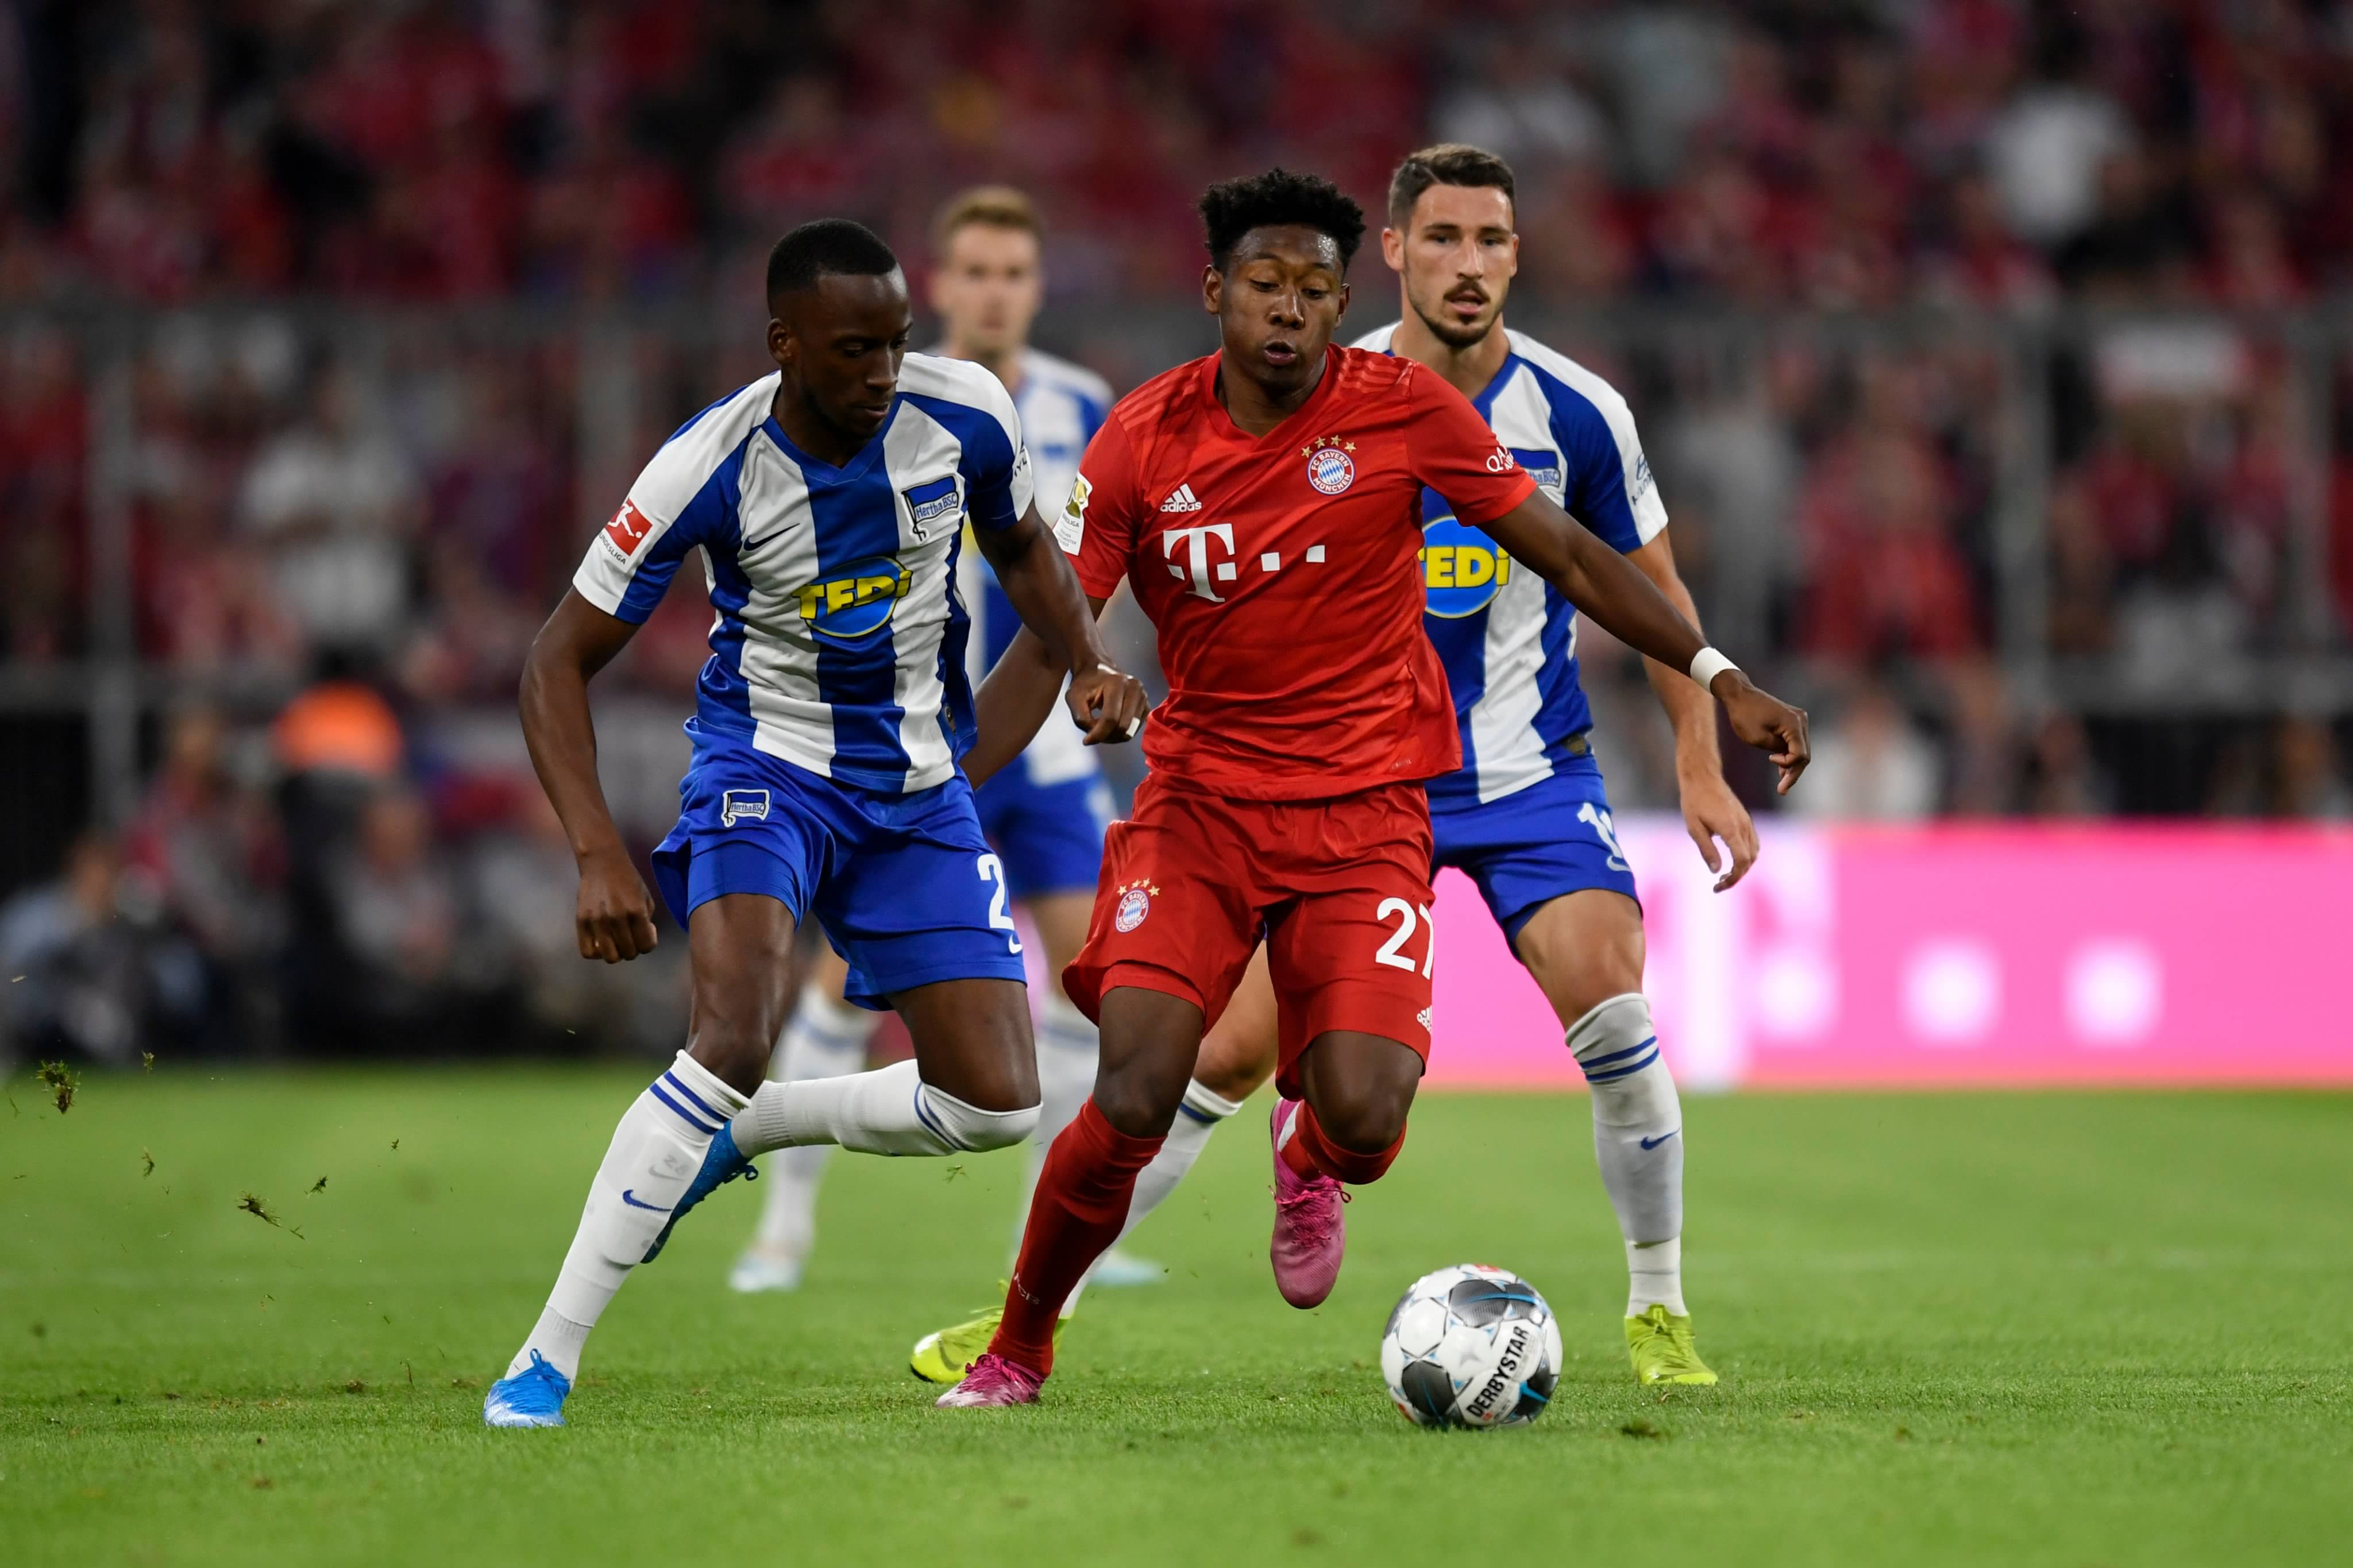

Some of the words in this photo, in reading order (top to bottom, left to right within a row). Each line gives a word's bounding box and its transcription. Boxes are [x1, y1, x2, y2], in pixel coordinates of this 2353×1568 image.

[1311, 459, 1320, 471] FC
[1318, 451, 1350, 467] BAYERN
[1543, 470, 1559, 484] BSC
[916, 502, 943, 519] Hertha
[942, 493, 957, 508] BSC
[1160, 500, 1202, 512] adidas
[598, 531, 627, 565] UNDESLIGA
[1417, 546, 1511, 588] EDi
[790, 569, 913, 620] TEDi
[752, 804, 763, 813] BSC
[1465, 1325, 1529, 1418] DERBYSTAR
